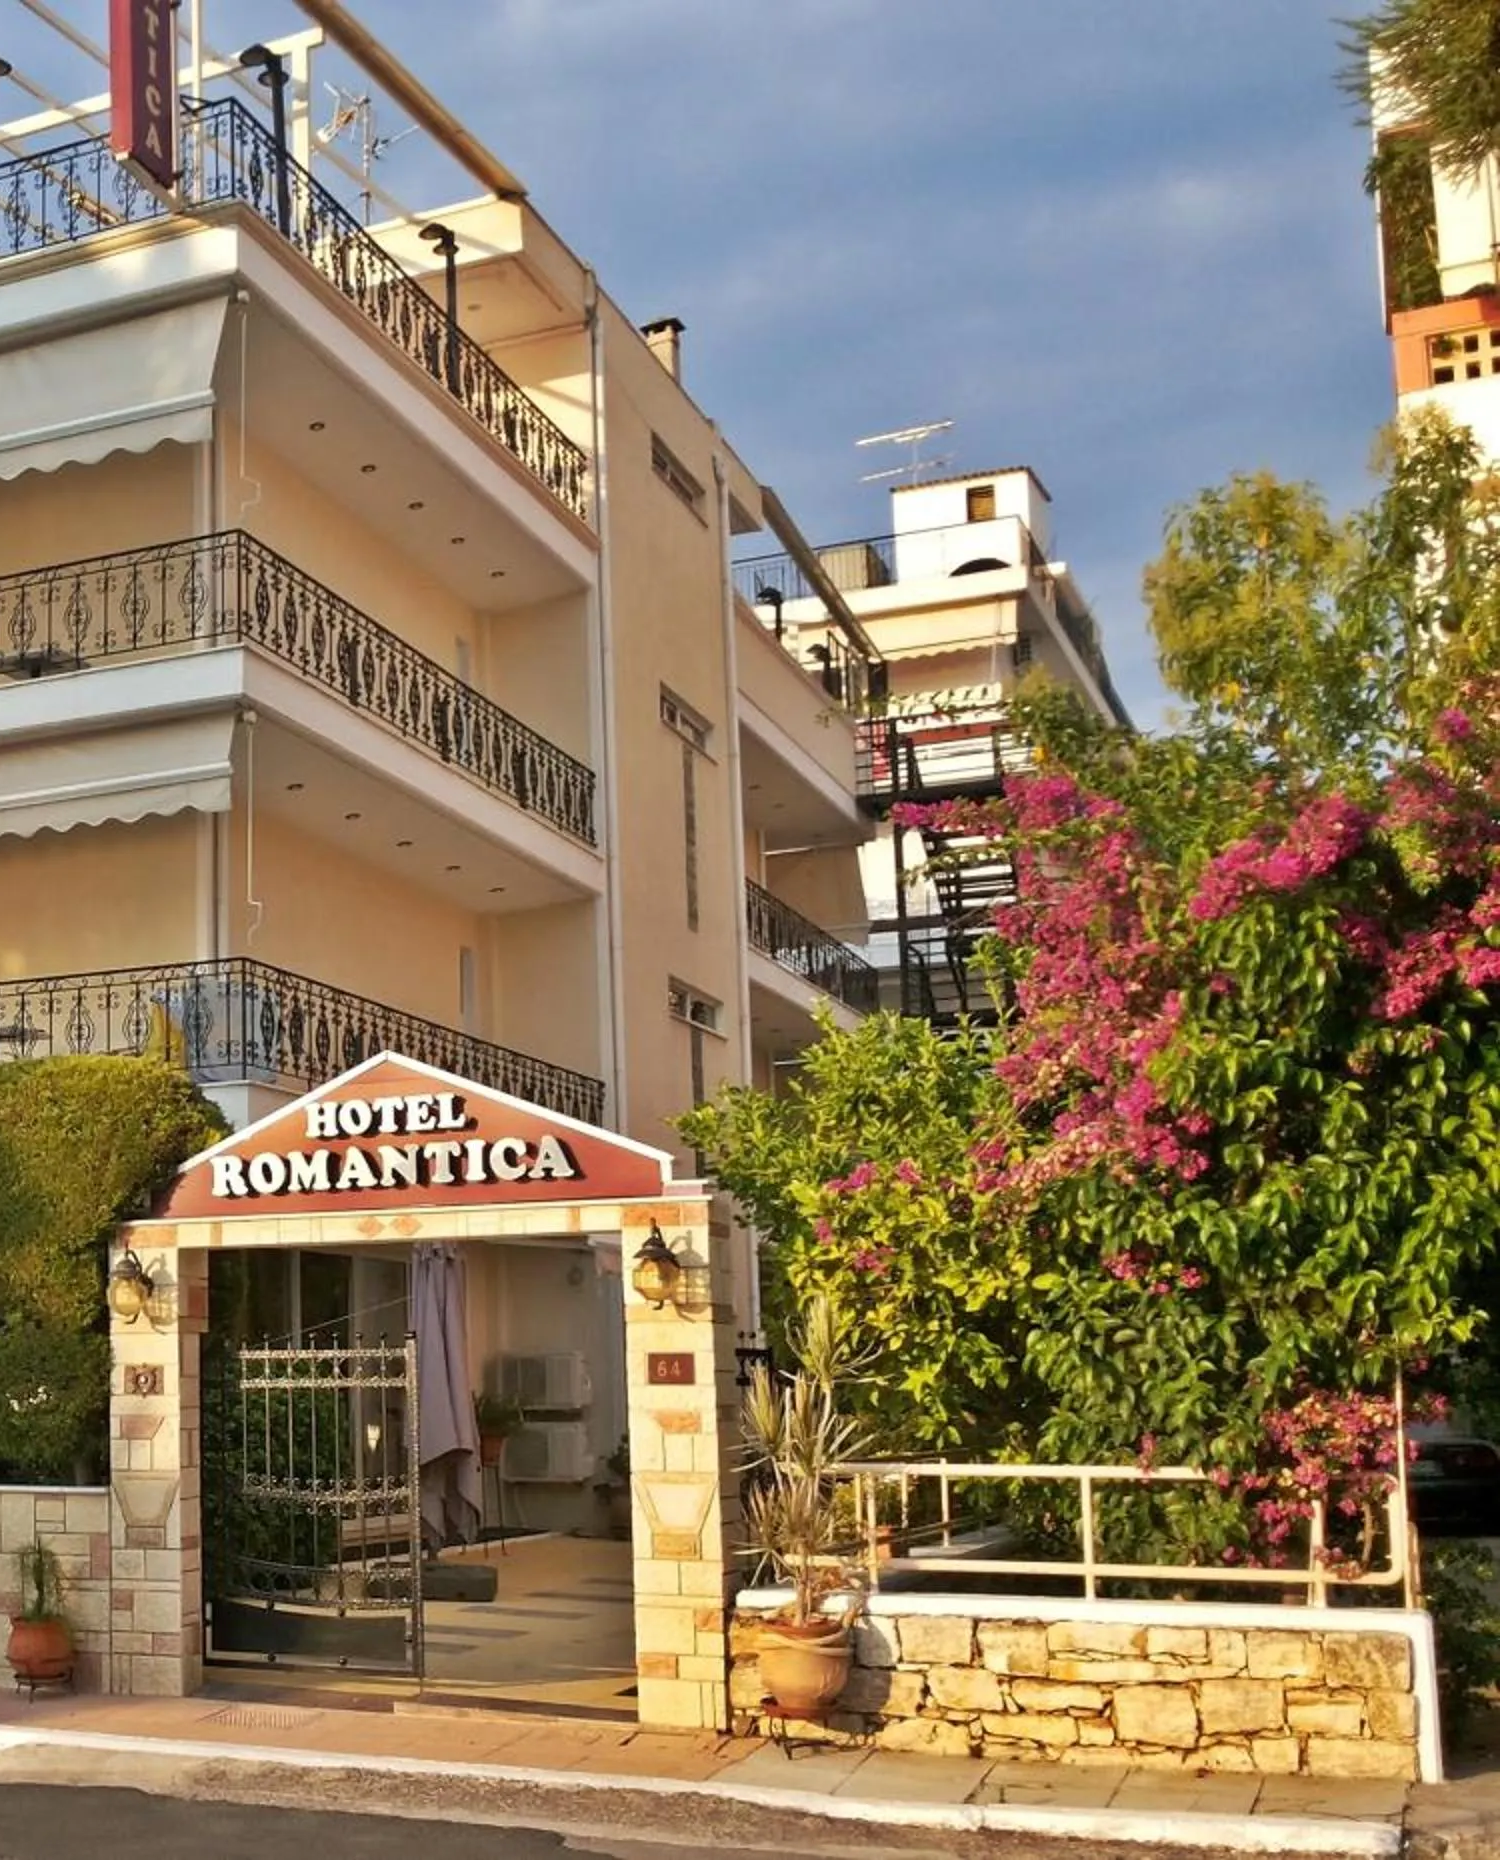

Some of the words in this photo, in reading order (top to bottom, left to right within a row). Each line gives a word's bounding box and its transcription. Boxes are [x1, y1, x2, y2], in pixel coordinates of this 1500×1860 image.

[144, 0, 163, 159] TICA
[305, 1092, 469, 1139] HOTEL
[210, 1135, 575, 1198] ROMANTICA
[657, 1359, 681, 1377] 64
